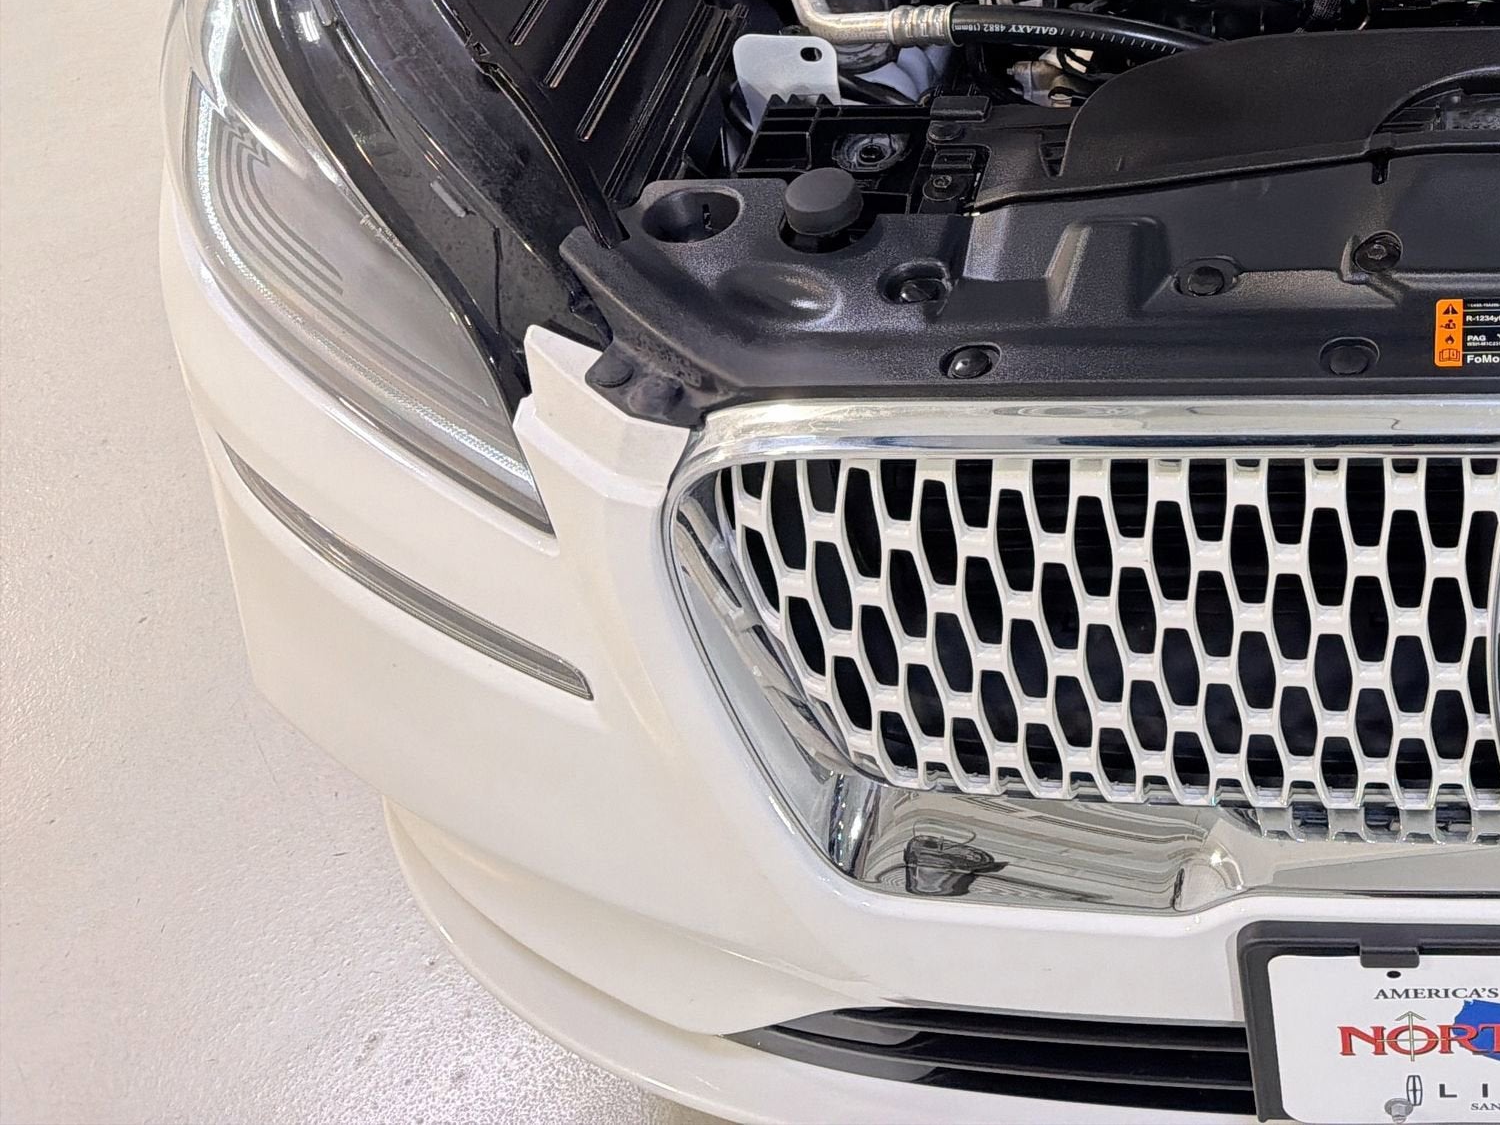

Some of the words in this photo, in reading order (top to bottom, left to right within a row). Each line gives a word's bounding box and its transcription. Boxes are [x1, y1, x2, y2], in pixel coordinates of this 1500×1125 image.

[983, 23, 1006, 33] 4882
[1007, 23, 1058, 36] GALAXY
[1467, 334, 1487, 342] PAG
[1373, 987, 1499, 1000] AMERICA'S
